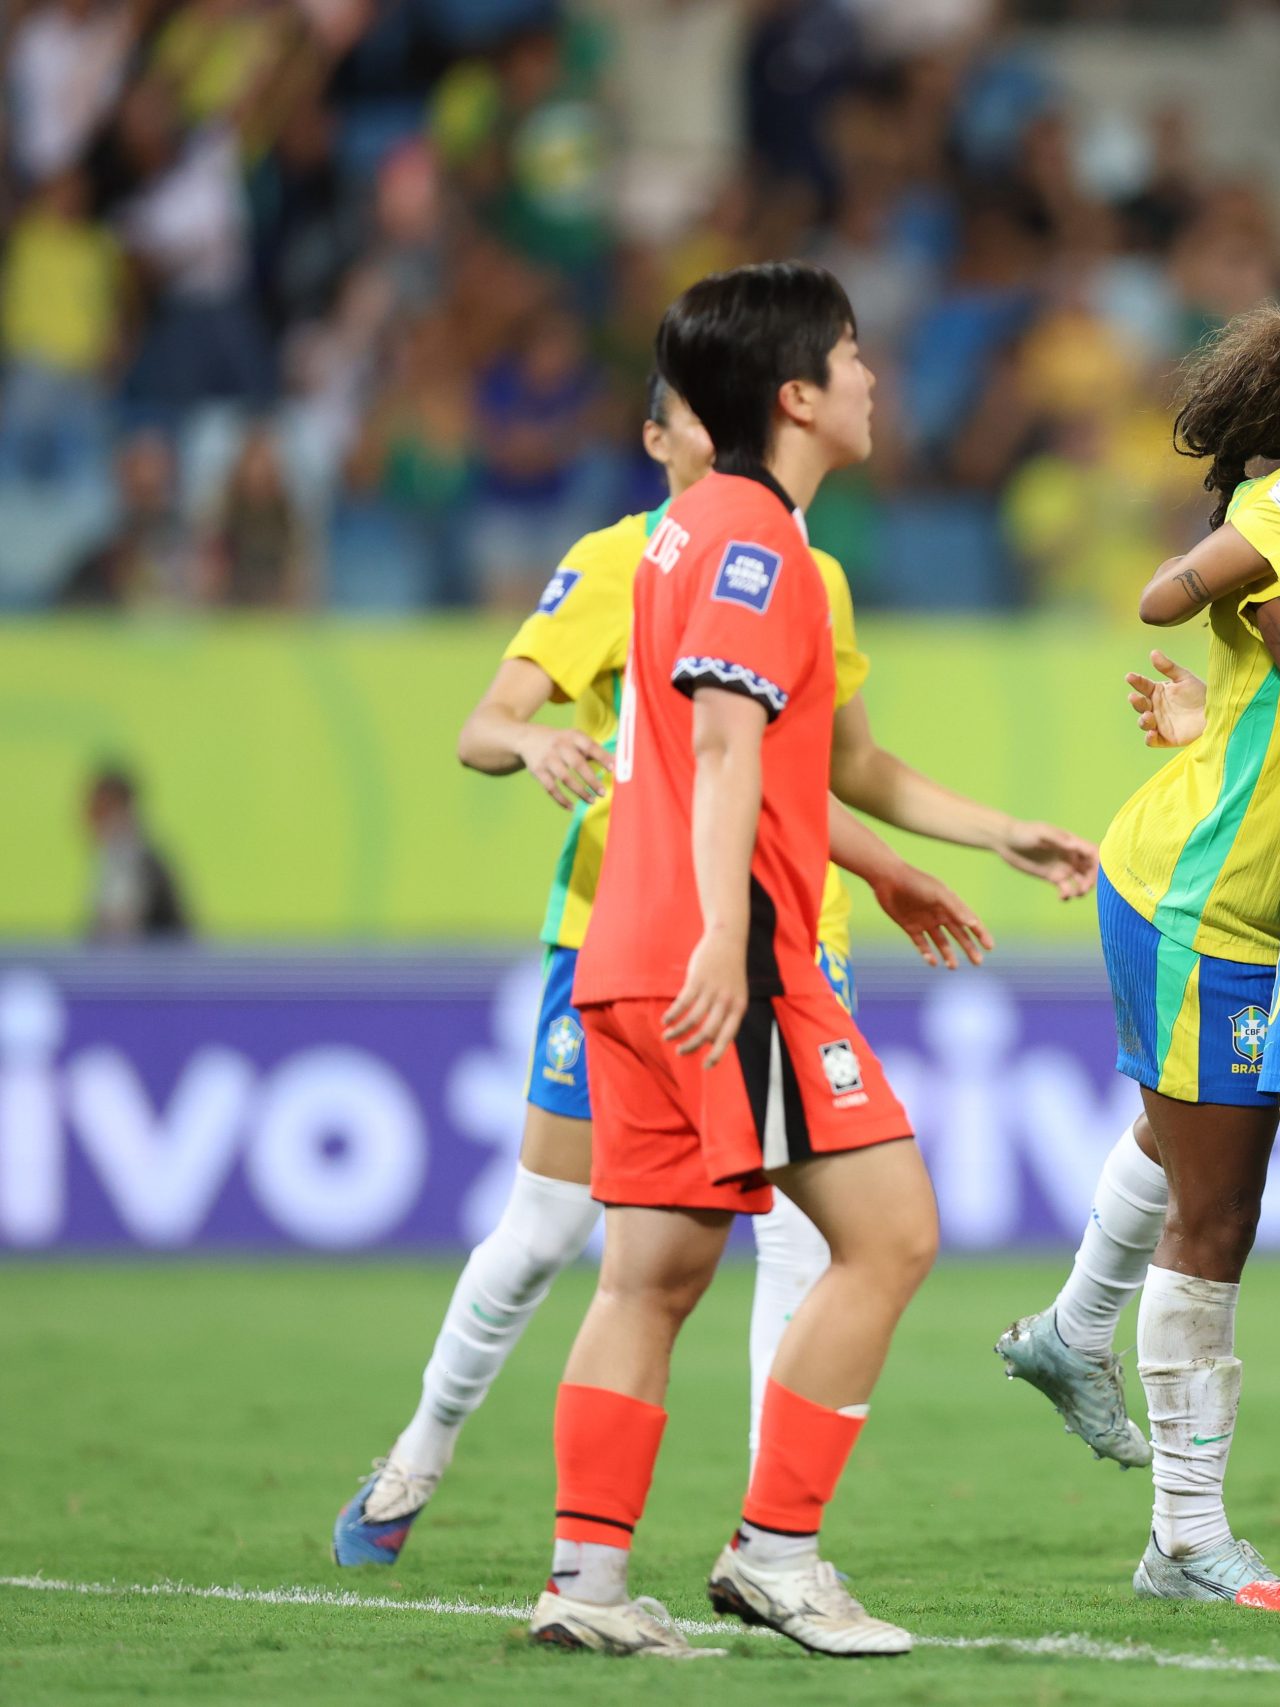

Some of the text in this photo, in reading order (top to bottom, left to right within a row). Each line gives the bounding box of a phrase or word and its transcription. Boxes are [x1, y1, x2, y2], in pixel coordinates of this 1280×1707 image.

[1244, 1028, 1261, 1036] CBF
[1231, 1063, 1263, 1074] BRAS
[0, 970, 428, 1249] ivo
